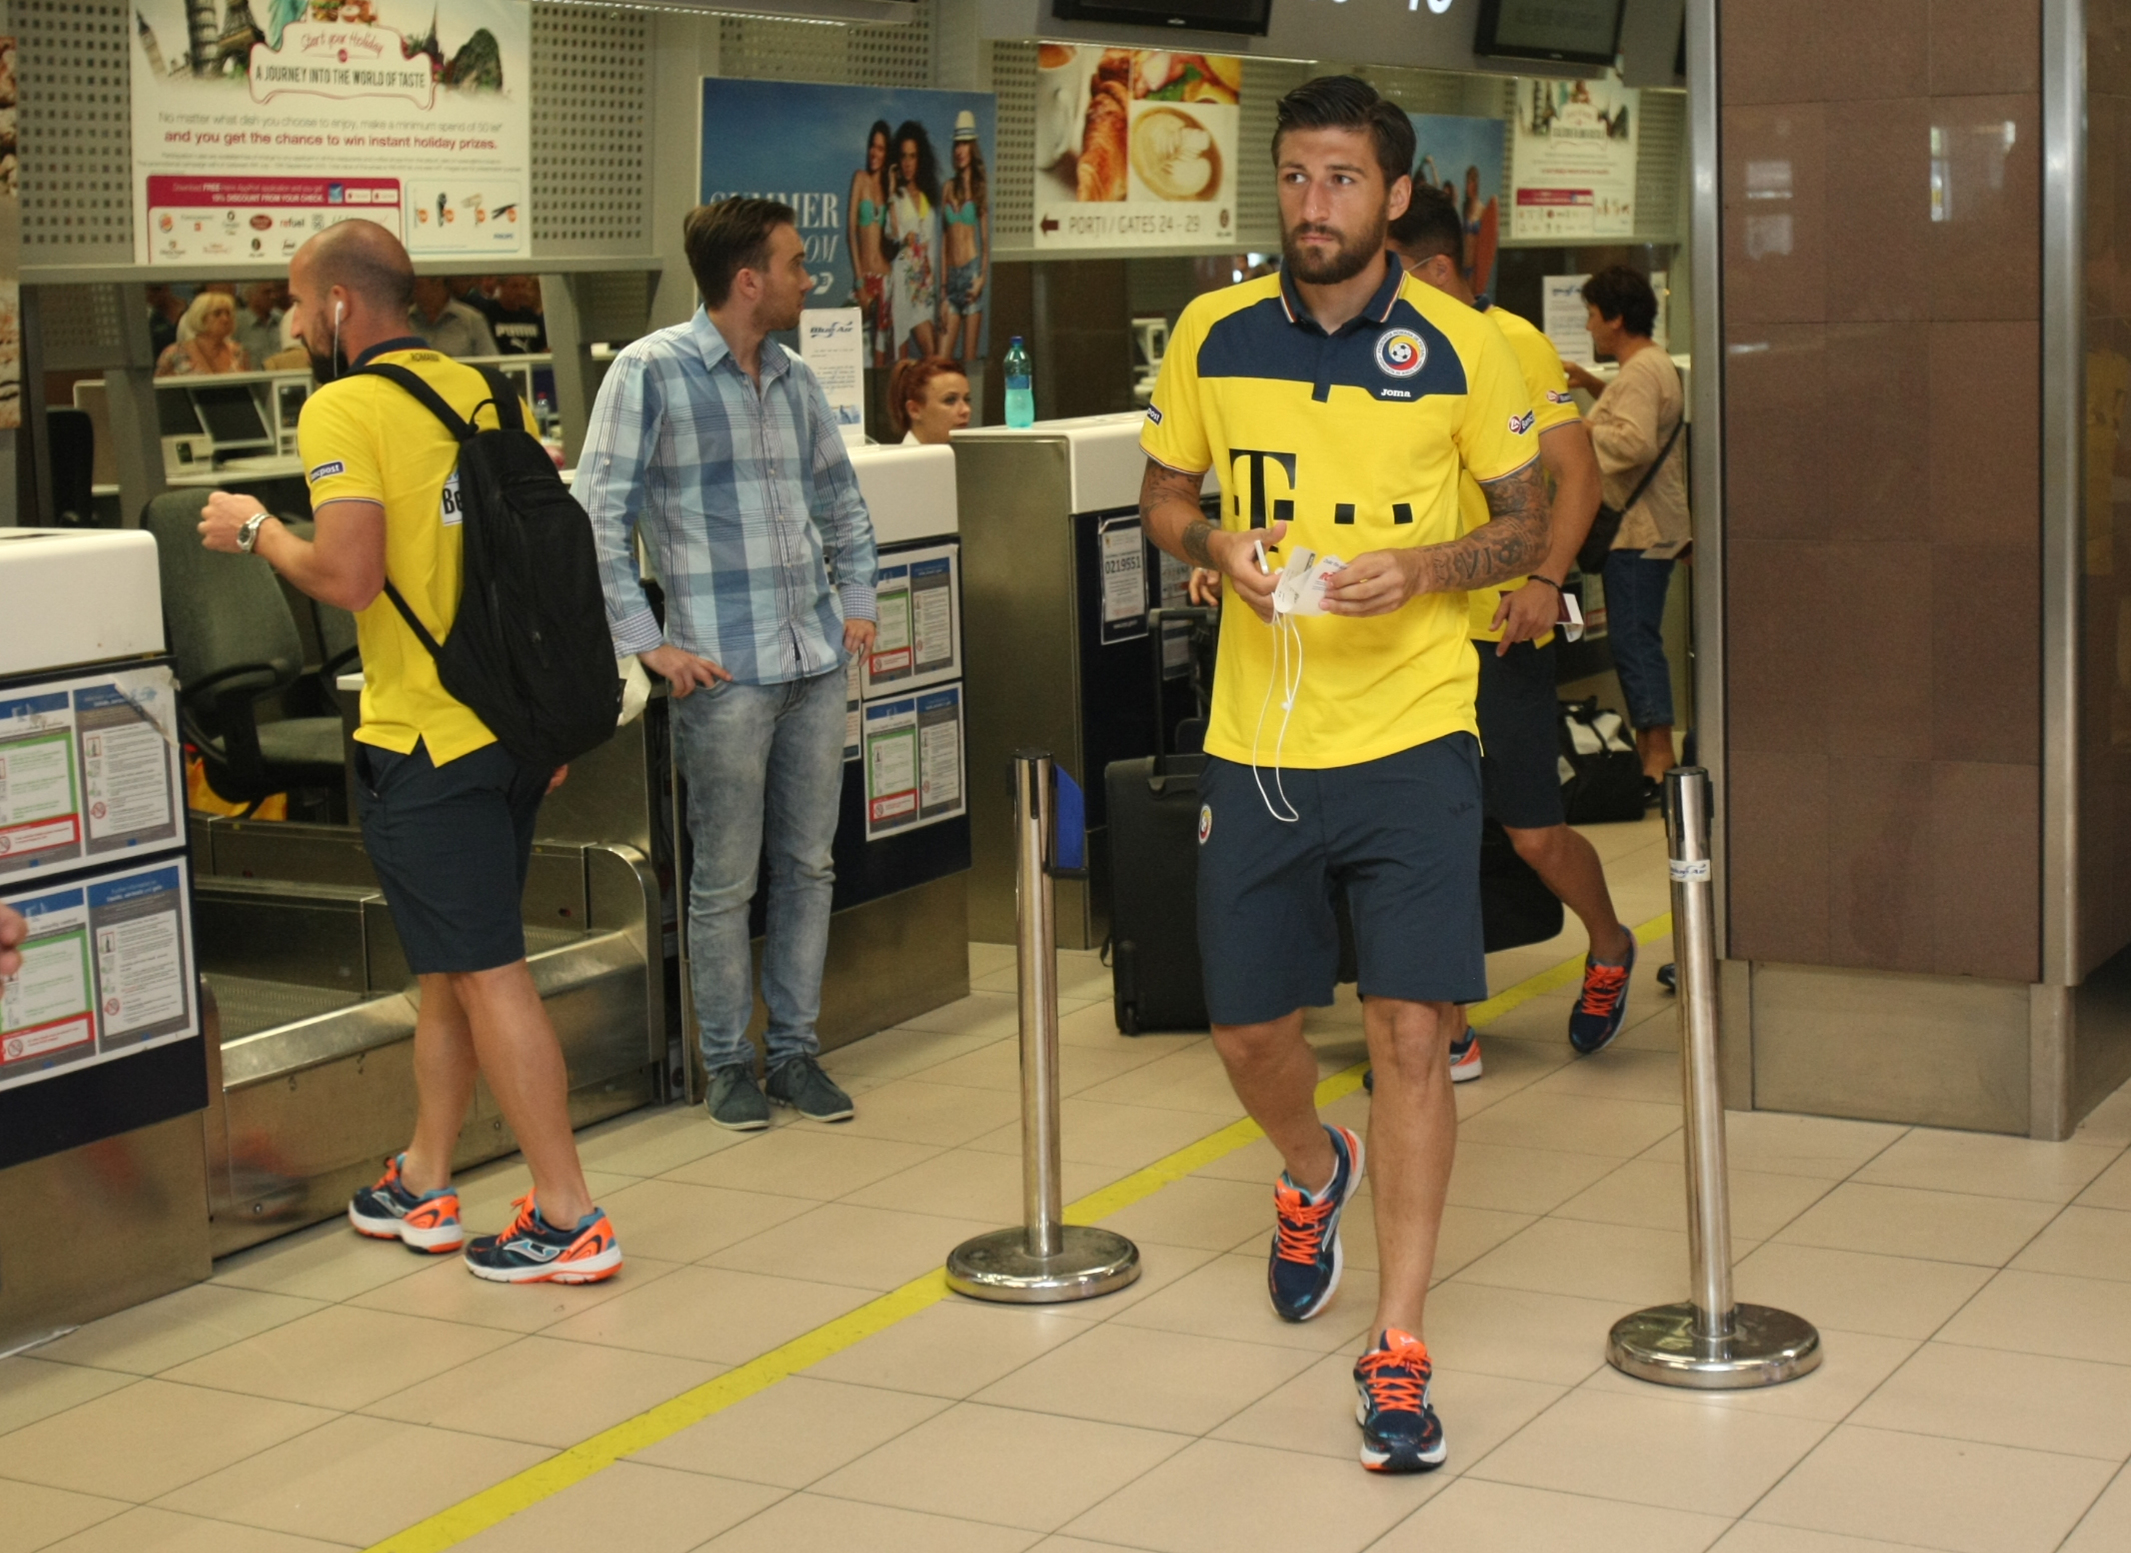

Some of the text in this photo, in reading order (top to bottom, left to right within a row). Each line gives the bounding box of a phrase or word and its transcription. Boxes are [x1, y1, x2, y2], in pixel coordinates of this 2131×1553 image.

[255, 65, 426, 88] A JOURNEY INTO THE WORLD OF TASTE
[159, 112, 174, 123] No
[176, 113, 209, 125] matter
[213, 114, 237, 125] what
[262, 116, 280, 129] you
[280, 116, 317, 127] choose
[319, 117, 329, 128] to
[360, 120, 386, 130] make
[164, 129, 497, 151] and you get the chance to win instant holiday prizes.
[203, 183, 221, 192] FREE
[1118, 215, 1156, 234] GATES
[1159, 215, 1173, 233] 24
[1185, 215, 1199, 233] 29
